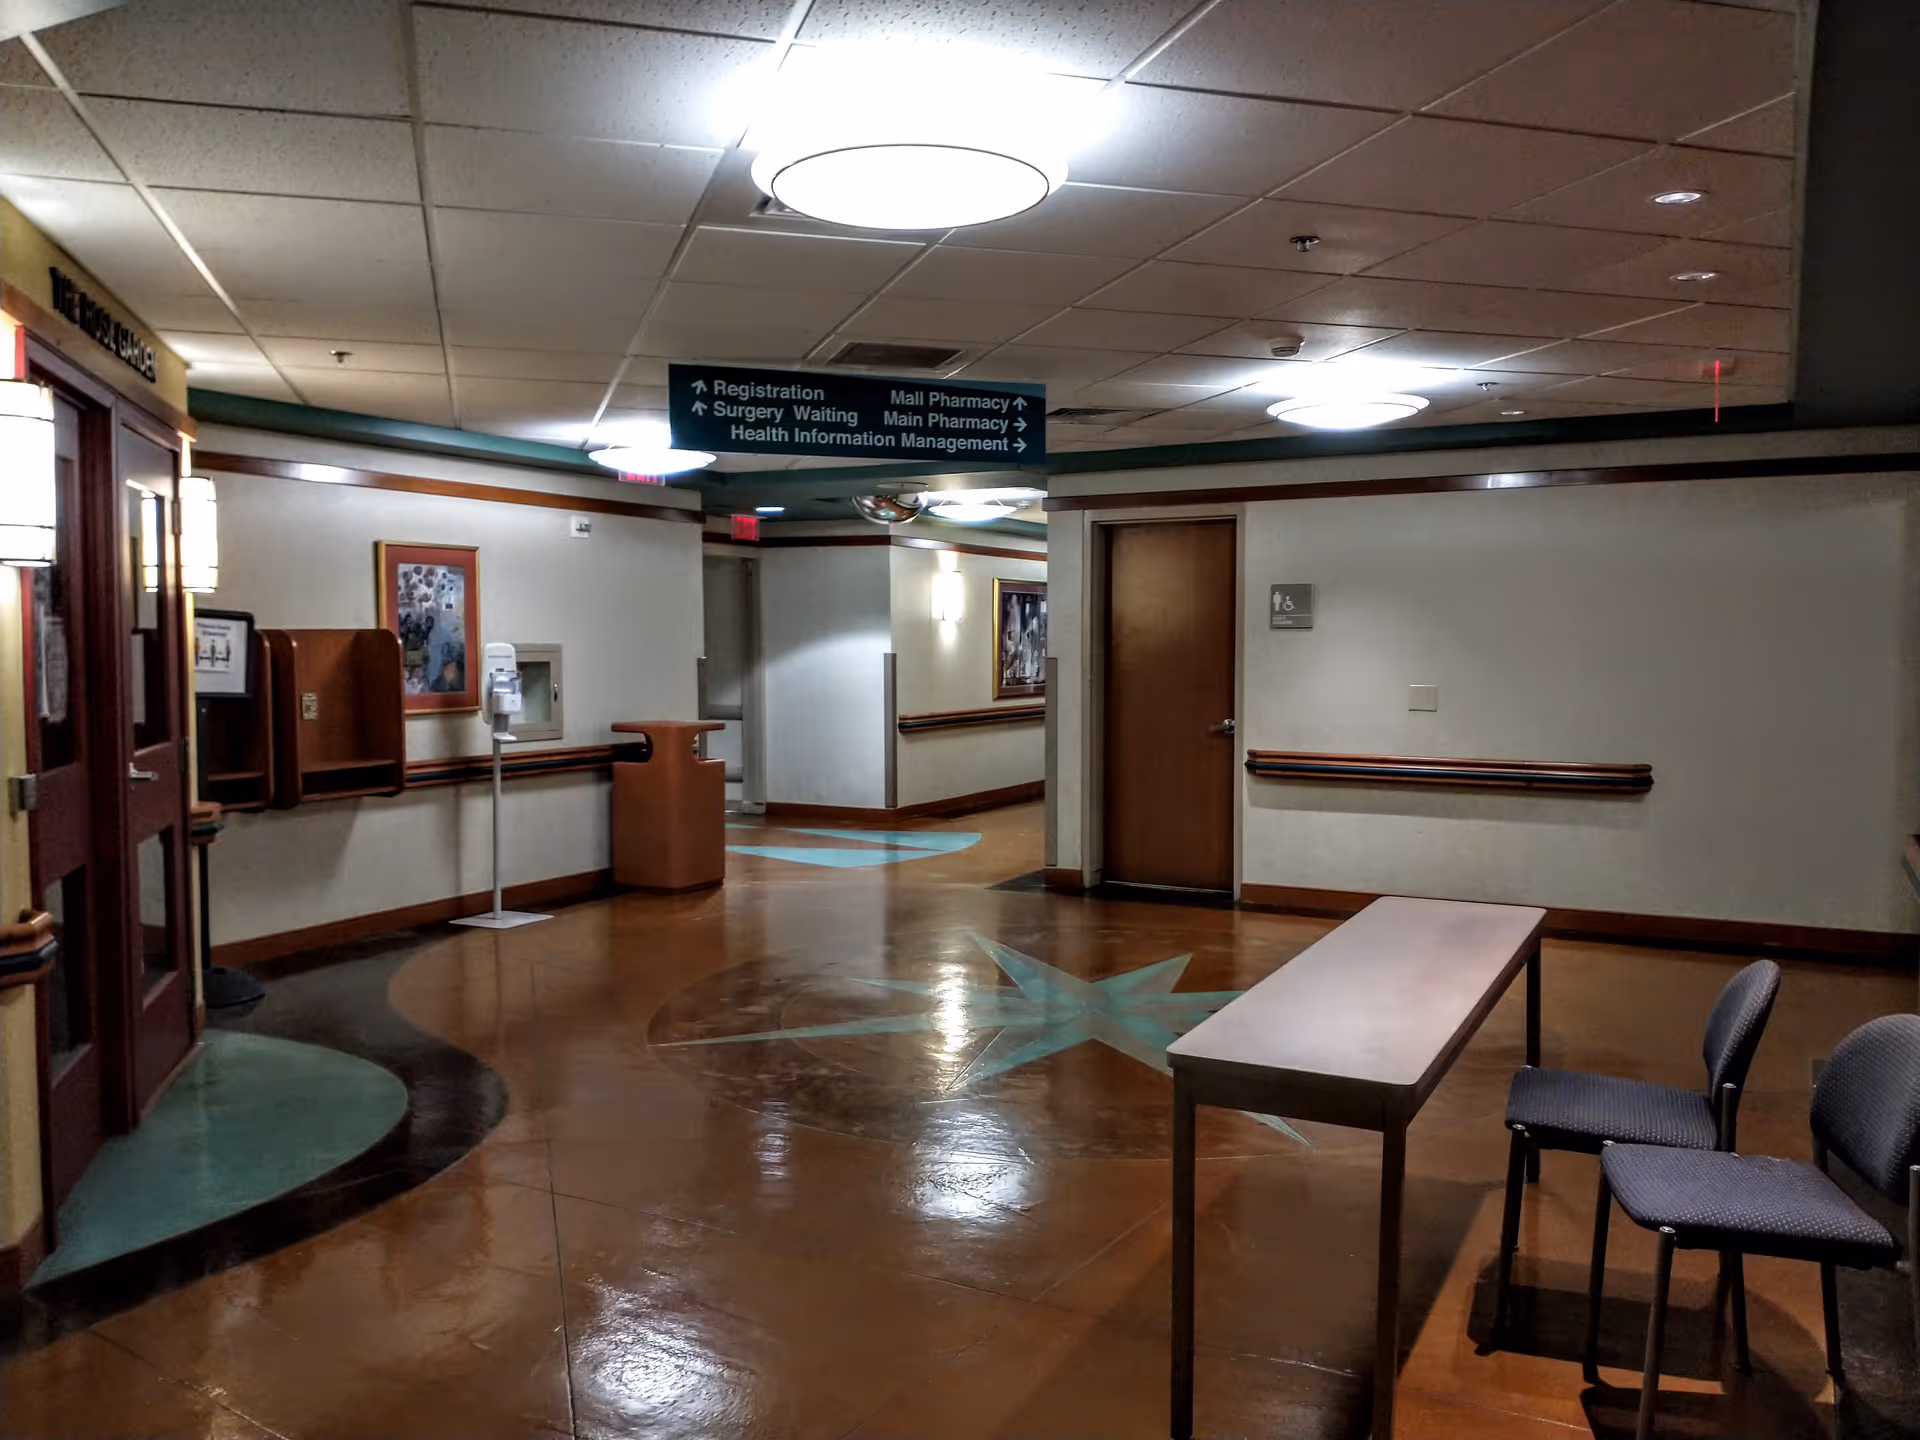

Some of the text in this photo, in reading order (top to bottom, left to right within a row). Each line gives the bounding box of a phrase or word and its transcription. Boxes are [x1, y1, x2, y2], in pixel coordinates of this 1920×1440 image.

[713, 380, 825, 400] Registration
[713, 401, 858, 427] Surgery Waiting
[928, 392, 1010, 413] Pharmacy
[883, 411, 1009, 434] Main Pharmacy
[731, 424, 1009, 453] Health Information Management
